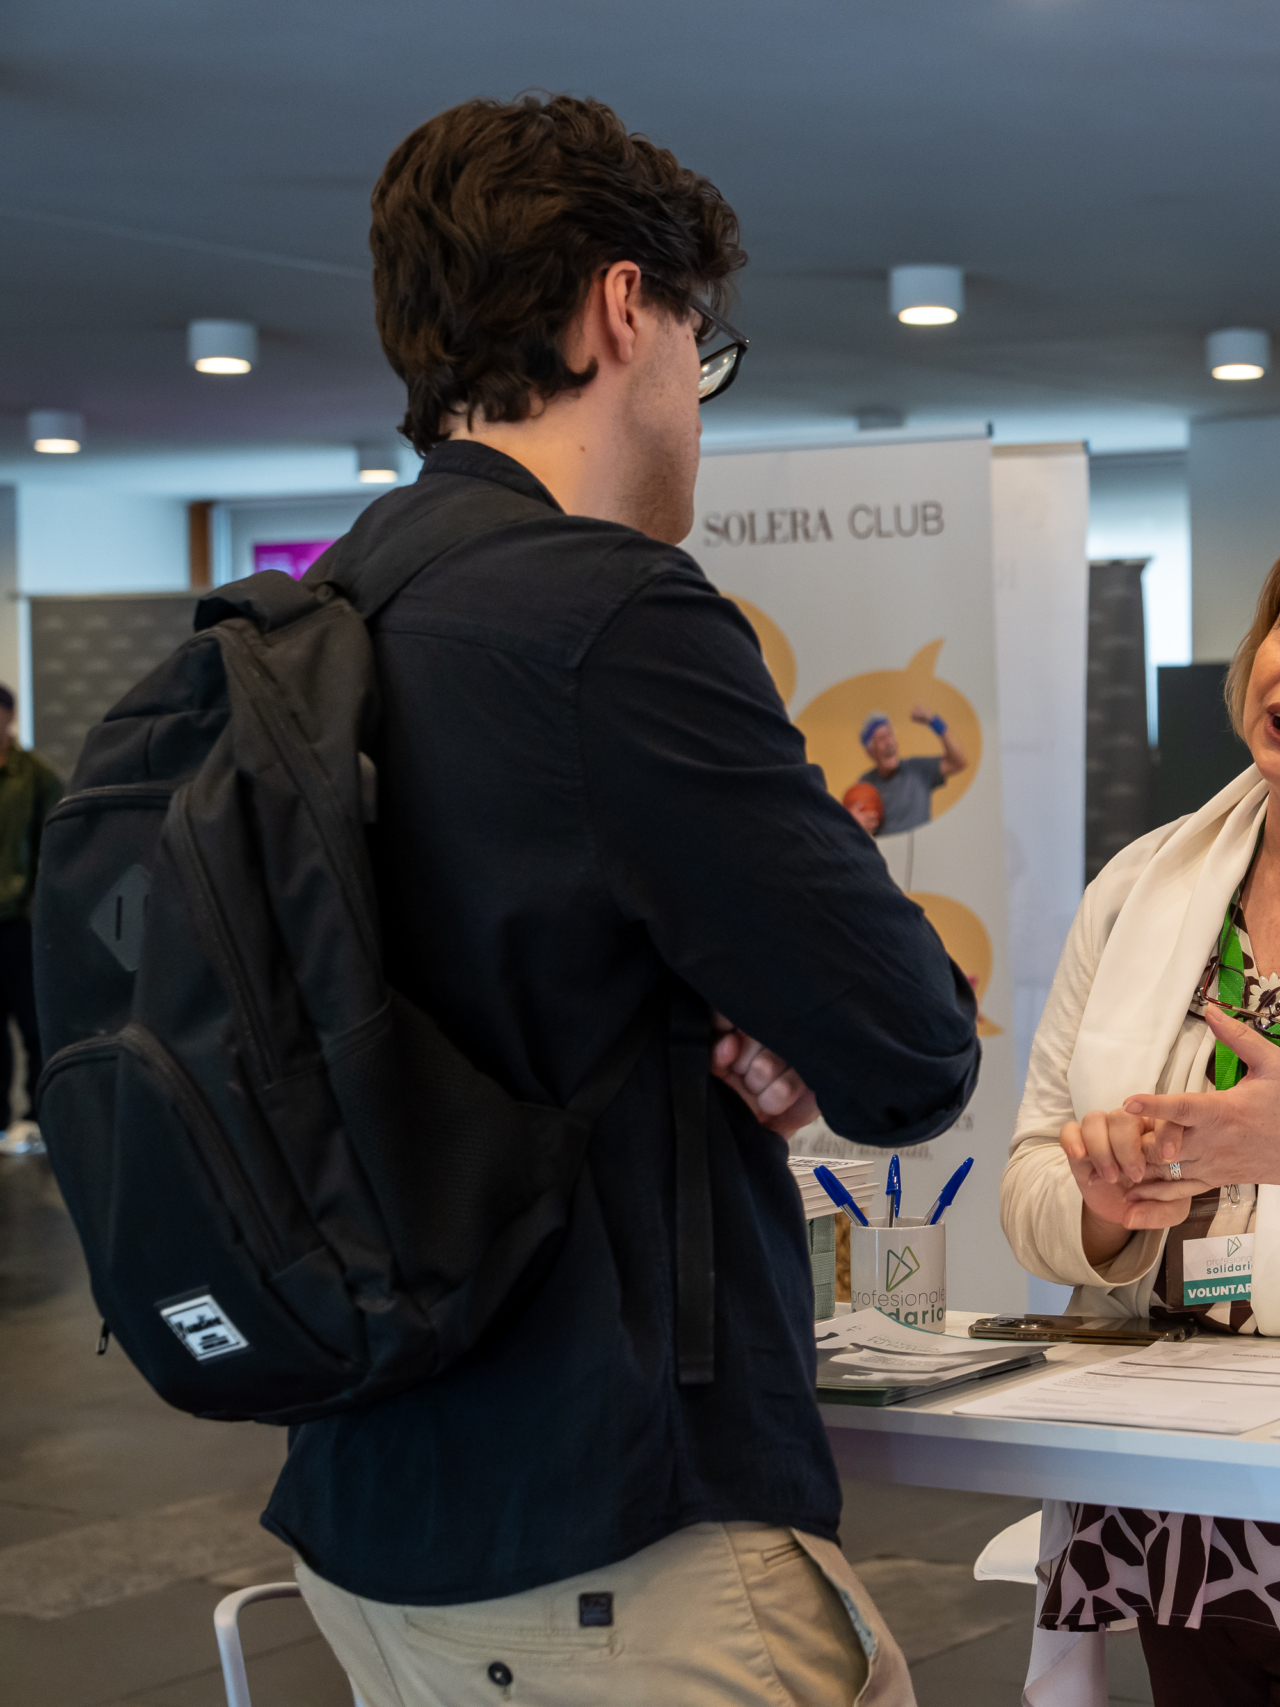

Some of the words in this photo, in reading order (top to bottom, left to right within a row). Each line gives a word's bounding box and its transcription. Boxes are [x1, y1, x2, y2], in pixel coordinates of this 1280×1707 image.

[703, 507, 833, 547] SOLERA
[847, 500, 945, 540] CLUB
[1206, 1256, 1252, 1268] profesiona
[1206, 1261, 1252, 1275] solidari
[852, 1286, 945, 1307] profesionale
[1188, 1282, 1252, 1299] VOLUNTAR
